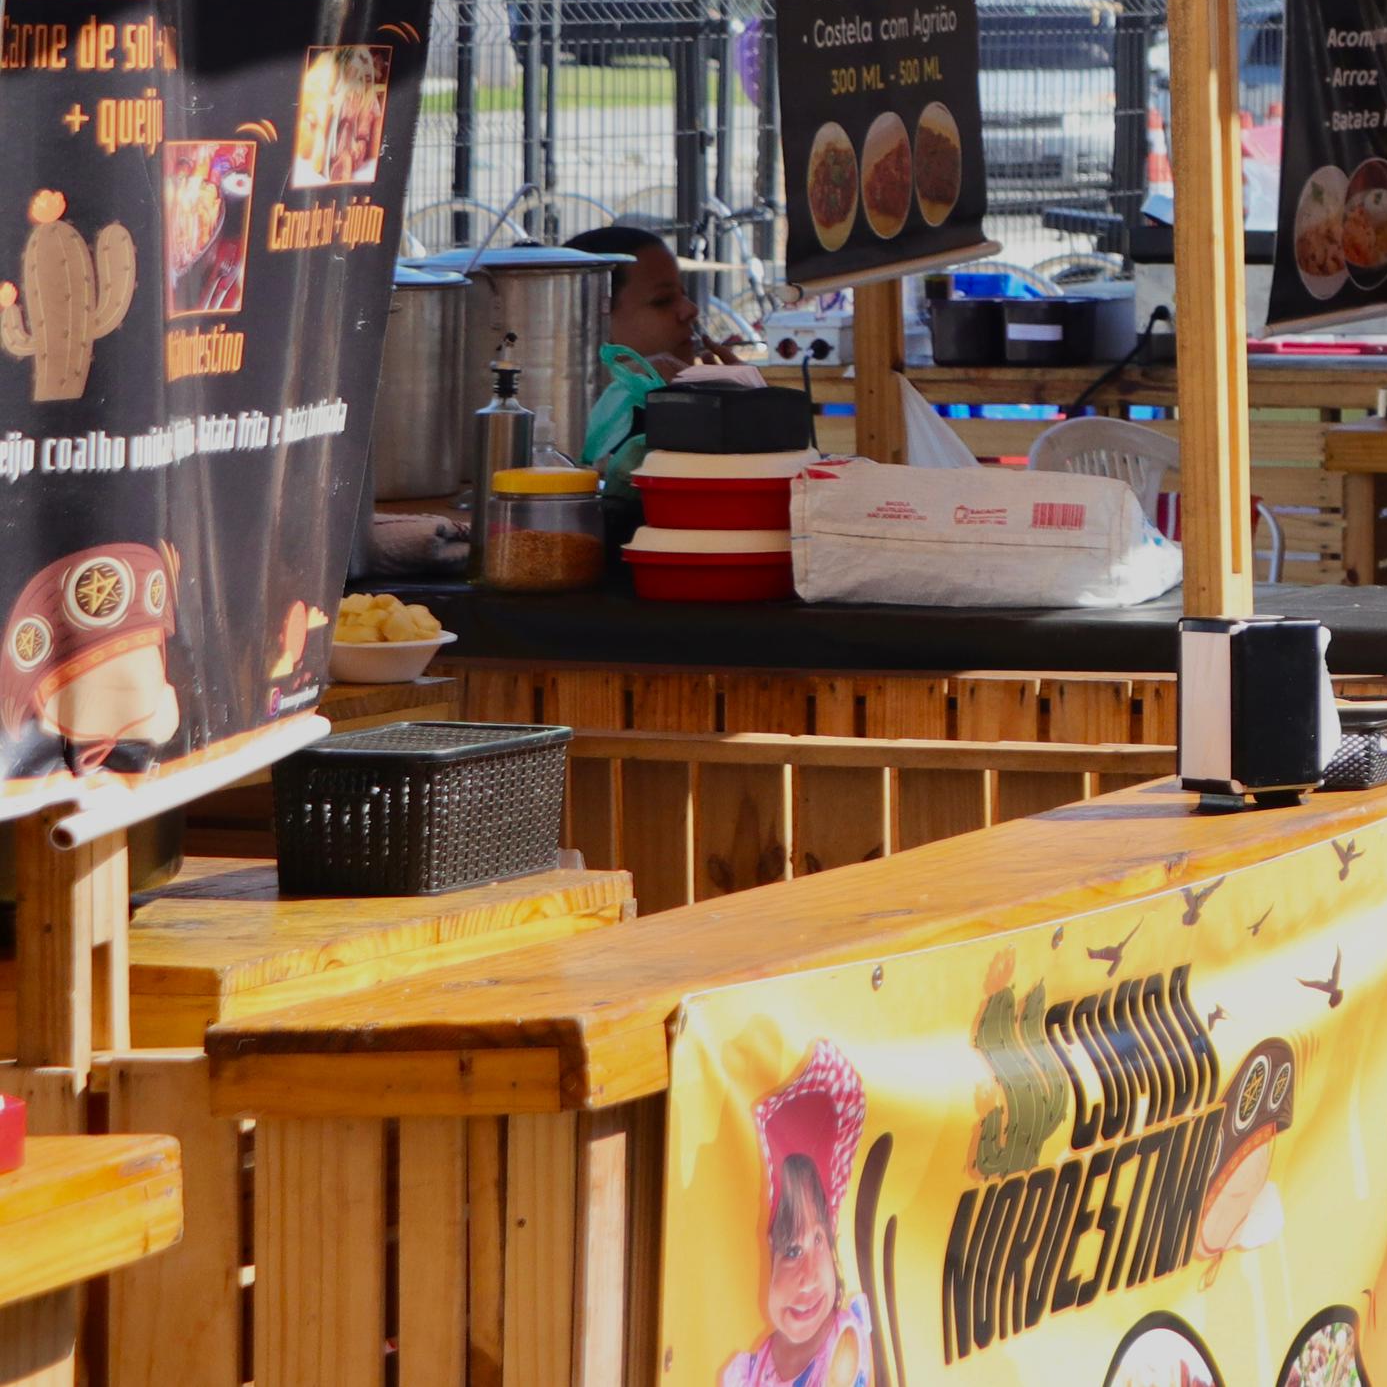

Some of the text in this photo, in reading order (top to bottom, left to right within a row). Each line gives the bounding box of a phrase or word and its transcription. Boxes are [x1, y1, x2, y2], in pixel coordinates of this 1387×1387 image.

[76, 14, 116, 71] de
[122, 13, 156, 71] sol
[813, 4, 958, 49] Costela com Agrião
[830, 66, 857, 96] 300
[861, 63, 885, 92] ML
[899, 56, 920, 86] 500
[922, 54, 944, 83] ML
[63, 87, 165, 156] + queijo
[268, 201, 310, 252] Carne
[341, 195, 385, 251] aipim
[40, 429, 127, 474] coalho
[236, 409, 270, 453] frita
[1043, 963, 1222, 1153] COMIDA
[941, 1104, 1228, 1366] NORDESTINA
